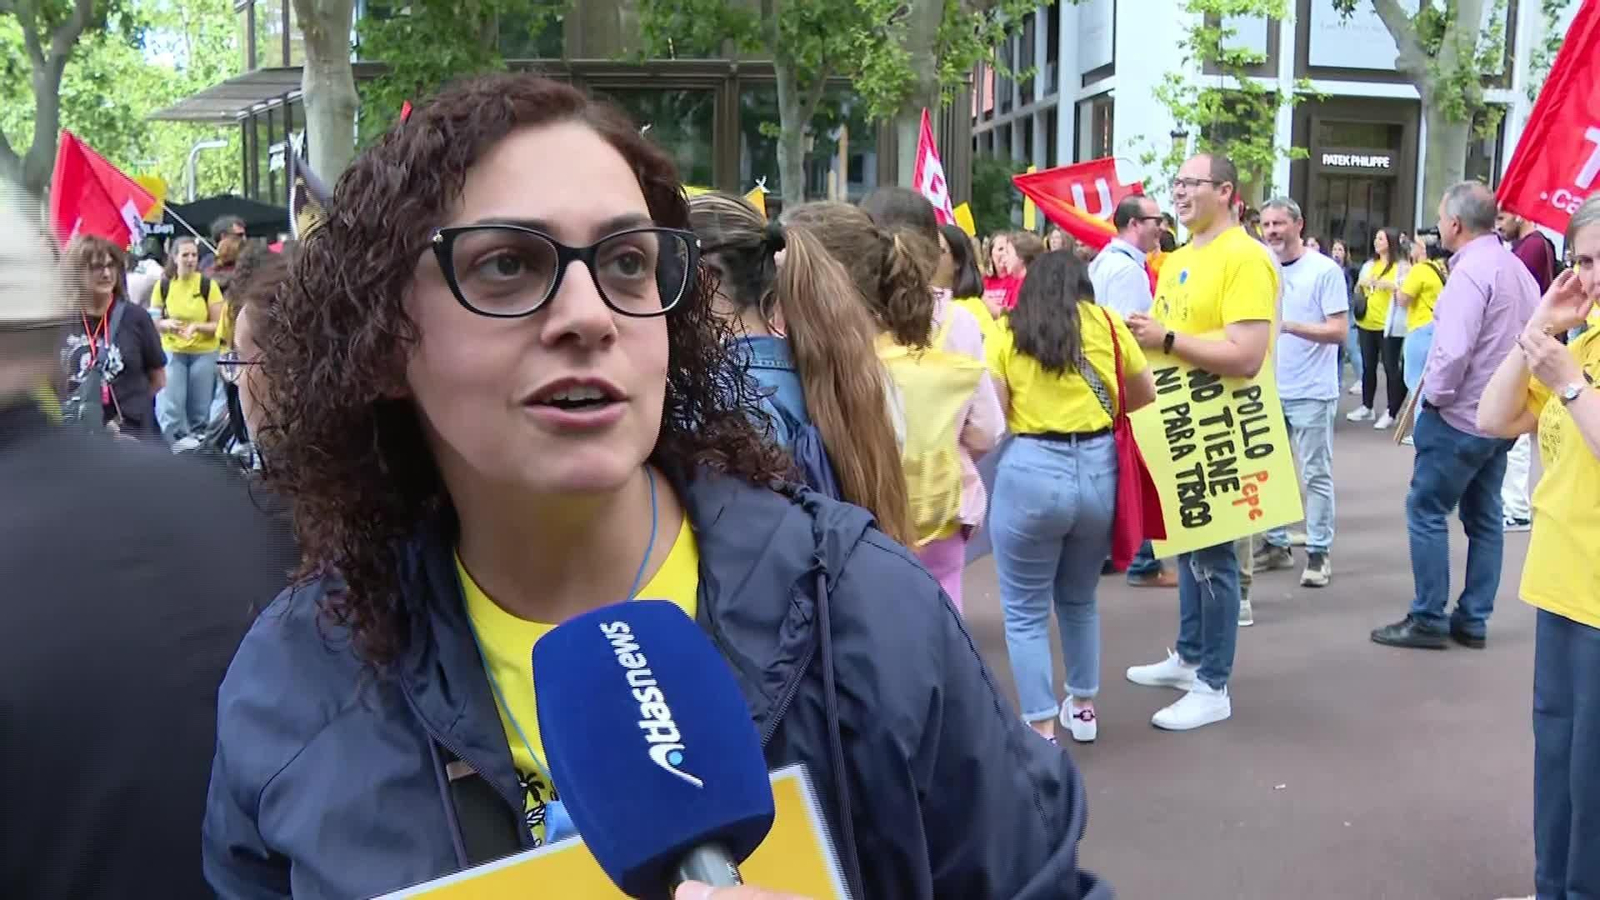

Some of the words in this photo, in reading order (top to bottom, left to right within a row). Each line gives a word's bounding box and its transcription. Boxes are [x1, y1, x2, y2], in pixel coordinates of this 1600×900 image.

[1322, 153, 1350, 166] PATEK
[1351, 154, 1390, 168] PHILIPPE
[1186, 367, 1225, 403] NO
[1160, 402, 1197, 461] PARA
[1232, 385, 1274, 460] POLLO
[1232, 470, 1269, 521] Pepe
